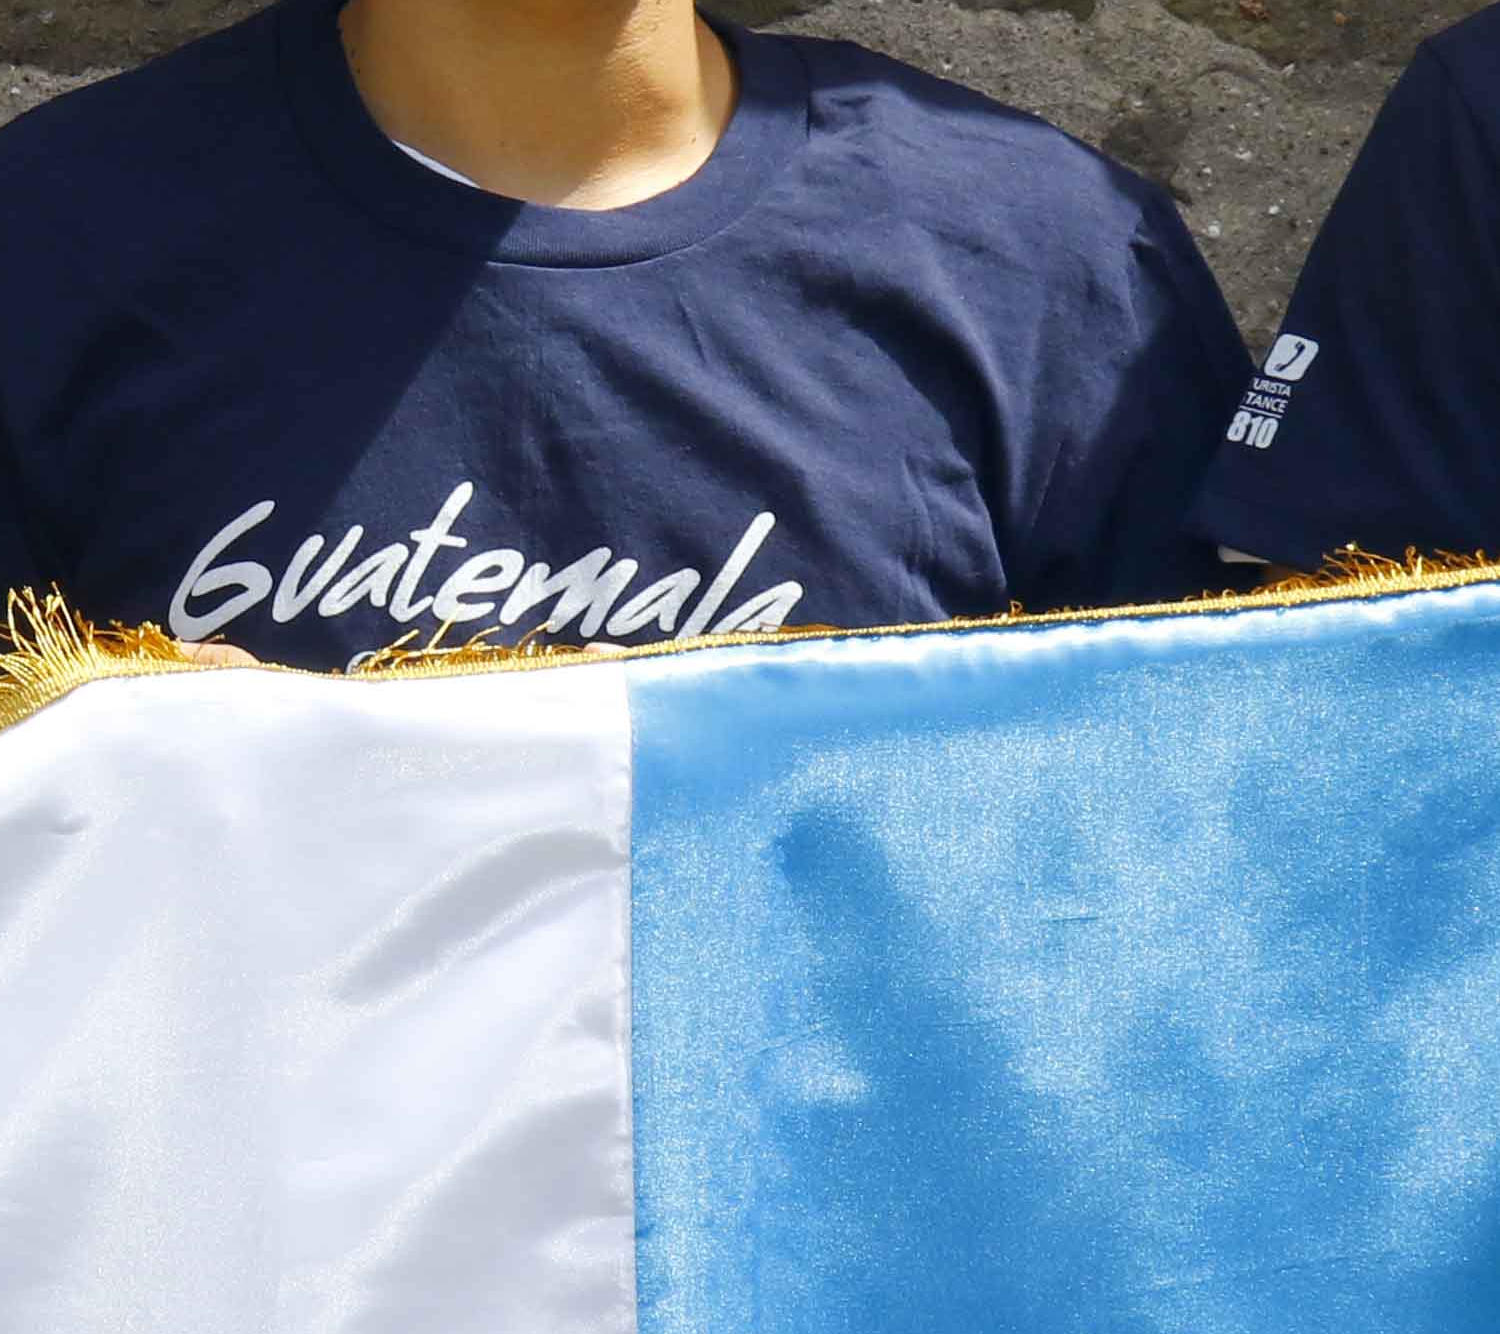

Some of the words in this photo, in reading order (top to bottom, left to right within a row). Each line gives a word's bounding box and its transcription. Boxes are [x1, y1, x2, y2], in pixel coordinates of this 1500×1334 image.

[1243, 391, 1288, 413] TANCE
[1251, 377, 1291, 397] URISTA
[1226, 410, 1279, 449] 810
[168, 481, 803, 640] Guatemala
